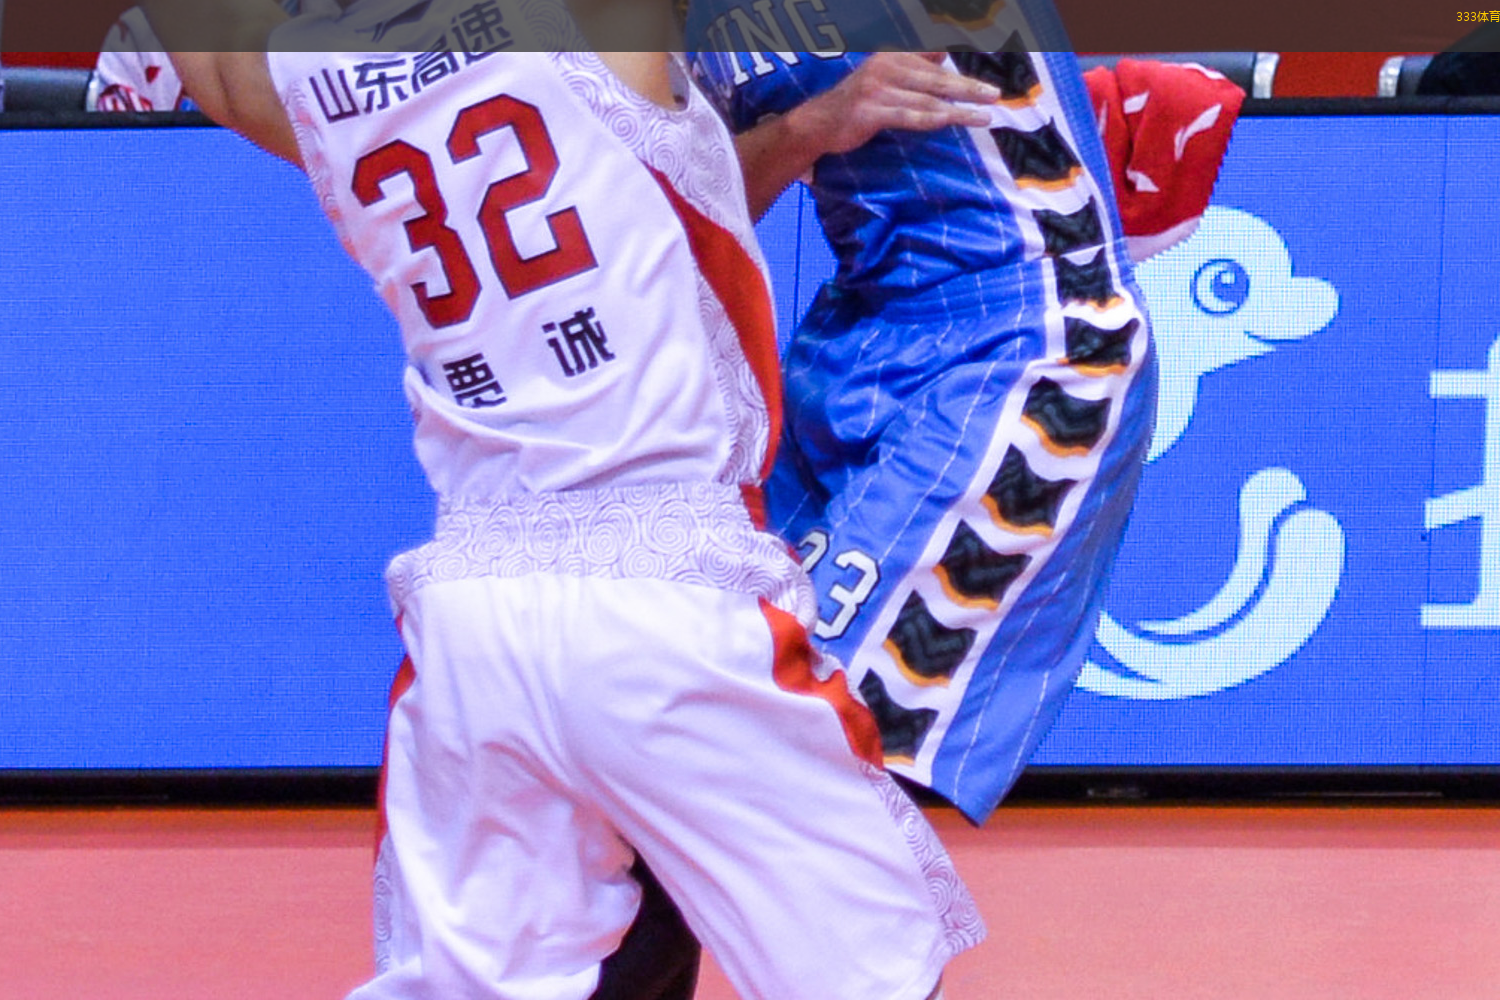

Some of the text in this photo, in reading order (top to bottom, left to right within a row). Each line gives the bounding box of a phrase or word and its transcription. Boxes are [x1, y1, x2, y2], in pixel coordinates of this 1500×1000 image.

[309, 0, 514, 124] 山东高速
[351, 93, 599, 330] 32
